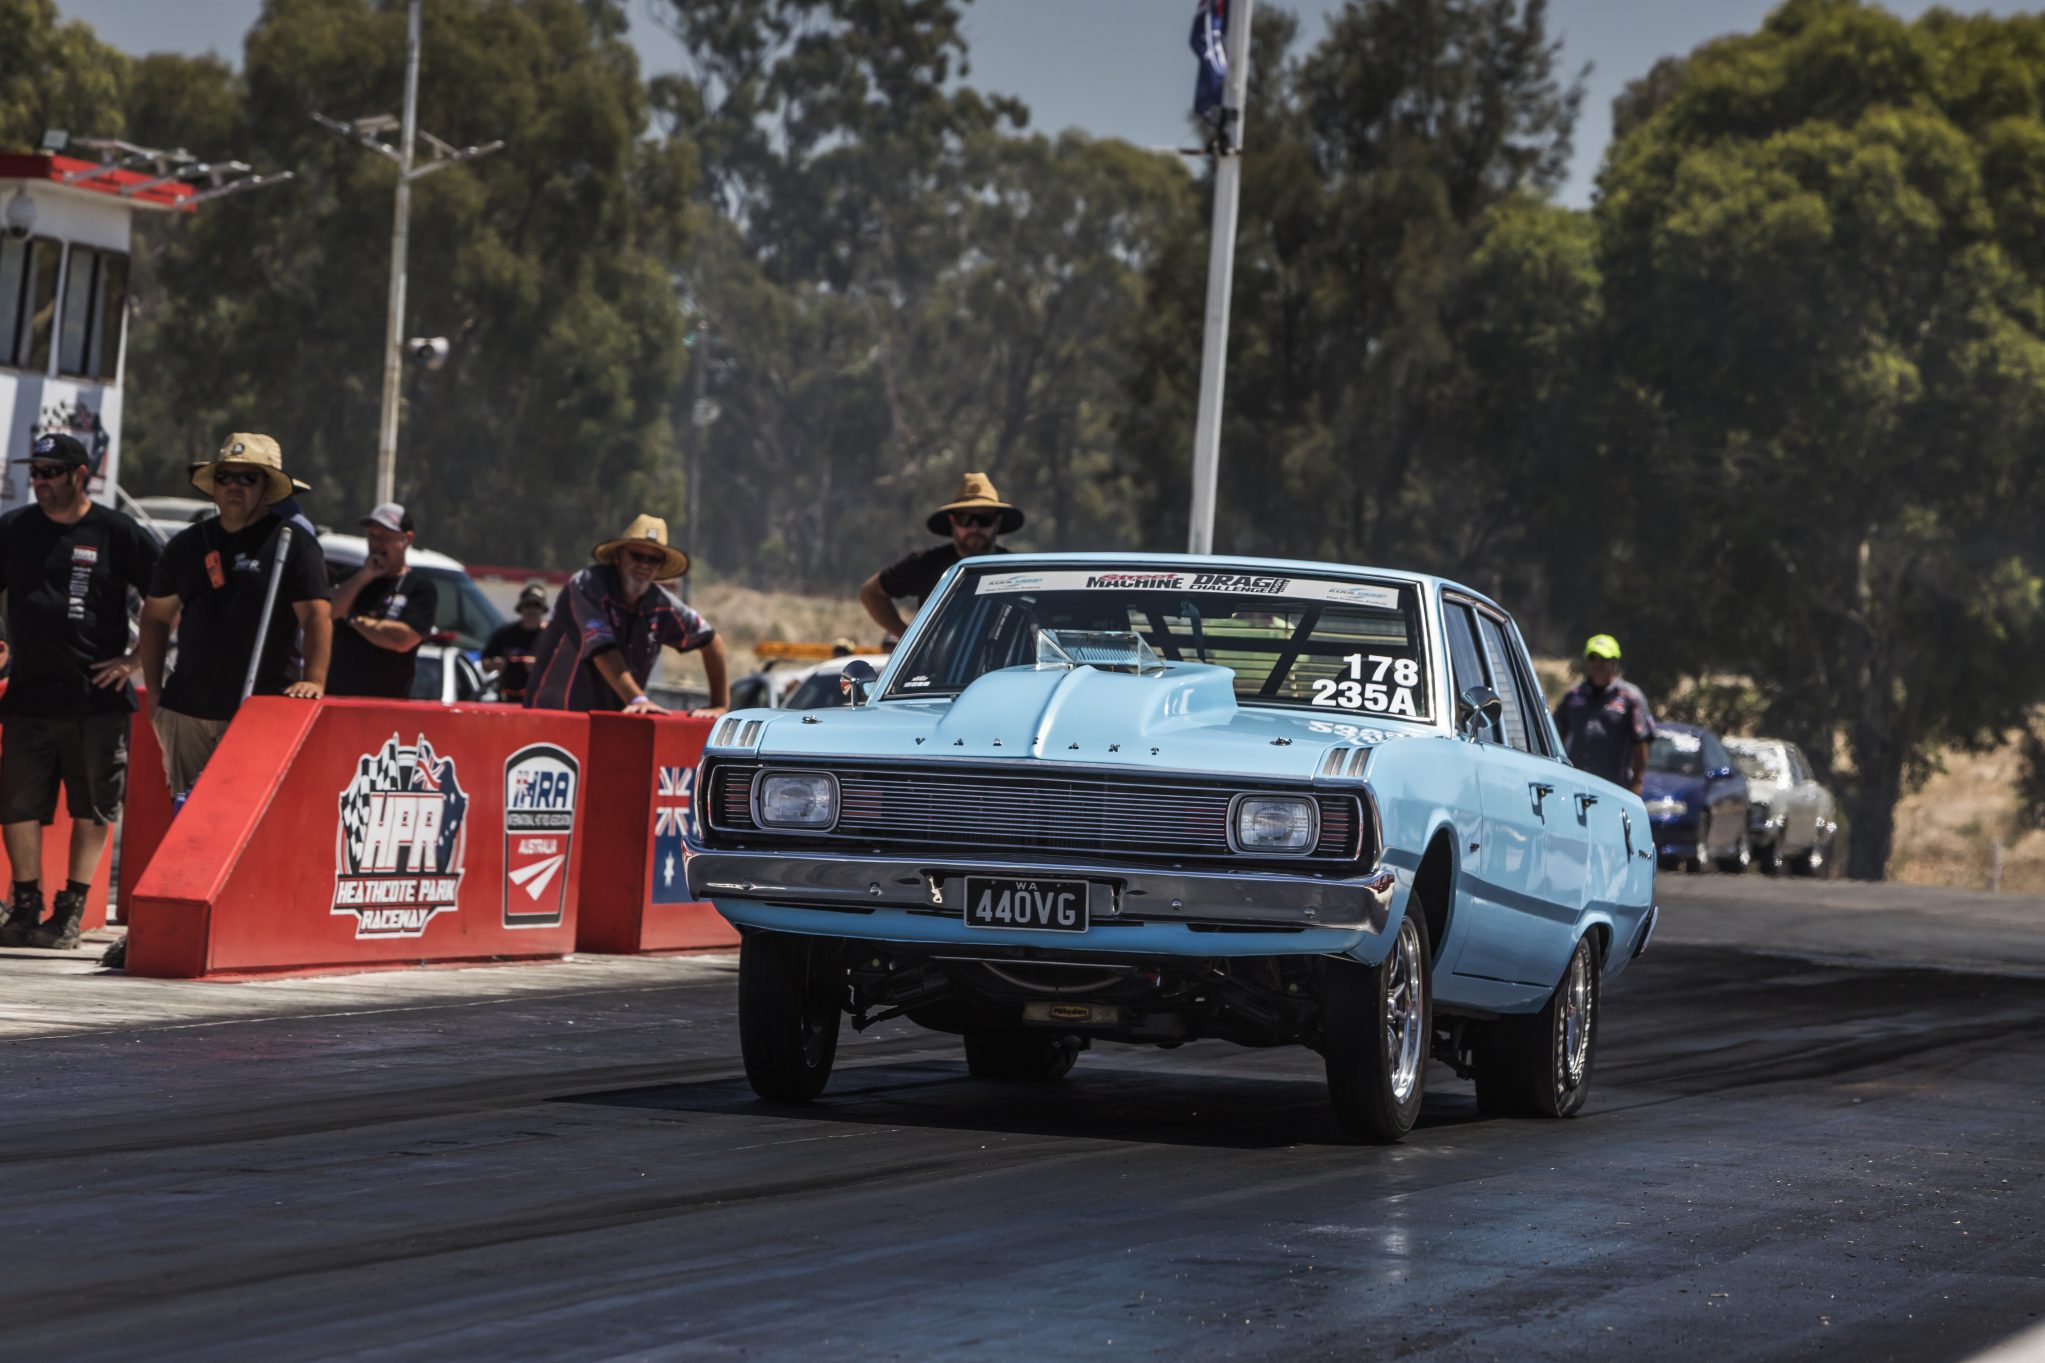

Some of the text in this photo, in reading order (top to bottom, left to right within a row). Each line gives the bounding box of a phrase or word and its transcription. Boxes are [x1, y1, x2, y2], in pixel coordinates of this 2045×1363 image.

[1086, 577, 1184, 589] MACHINE
[1189, 584, 1268, 593] CHALLENGE
[1192, 574, 1272, 588] DRAG
[1343, 653, 1418, 687] 178
[1311, 679, 1417, 716] 235A
[359, 791, 446, 873] HPR
[336, 879, 456, 904] HEATHCOTE PARK
[1015, 881, 1038, 891] WA
[360, 908, 430, 930] RACEWAY
[976, 889, 1076, 926] 440VG
